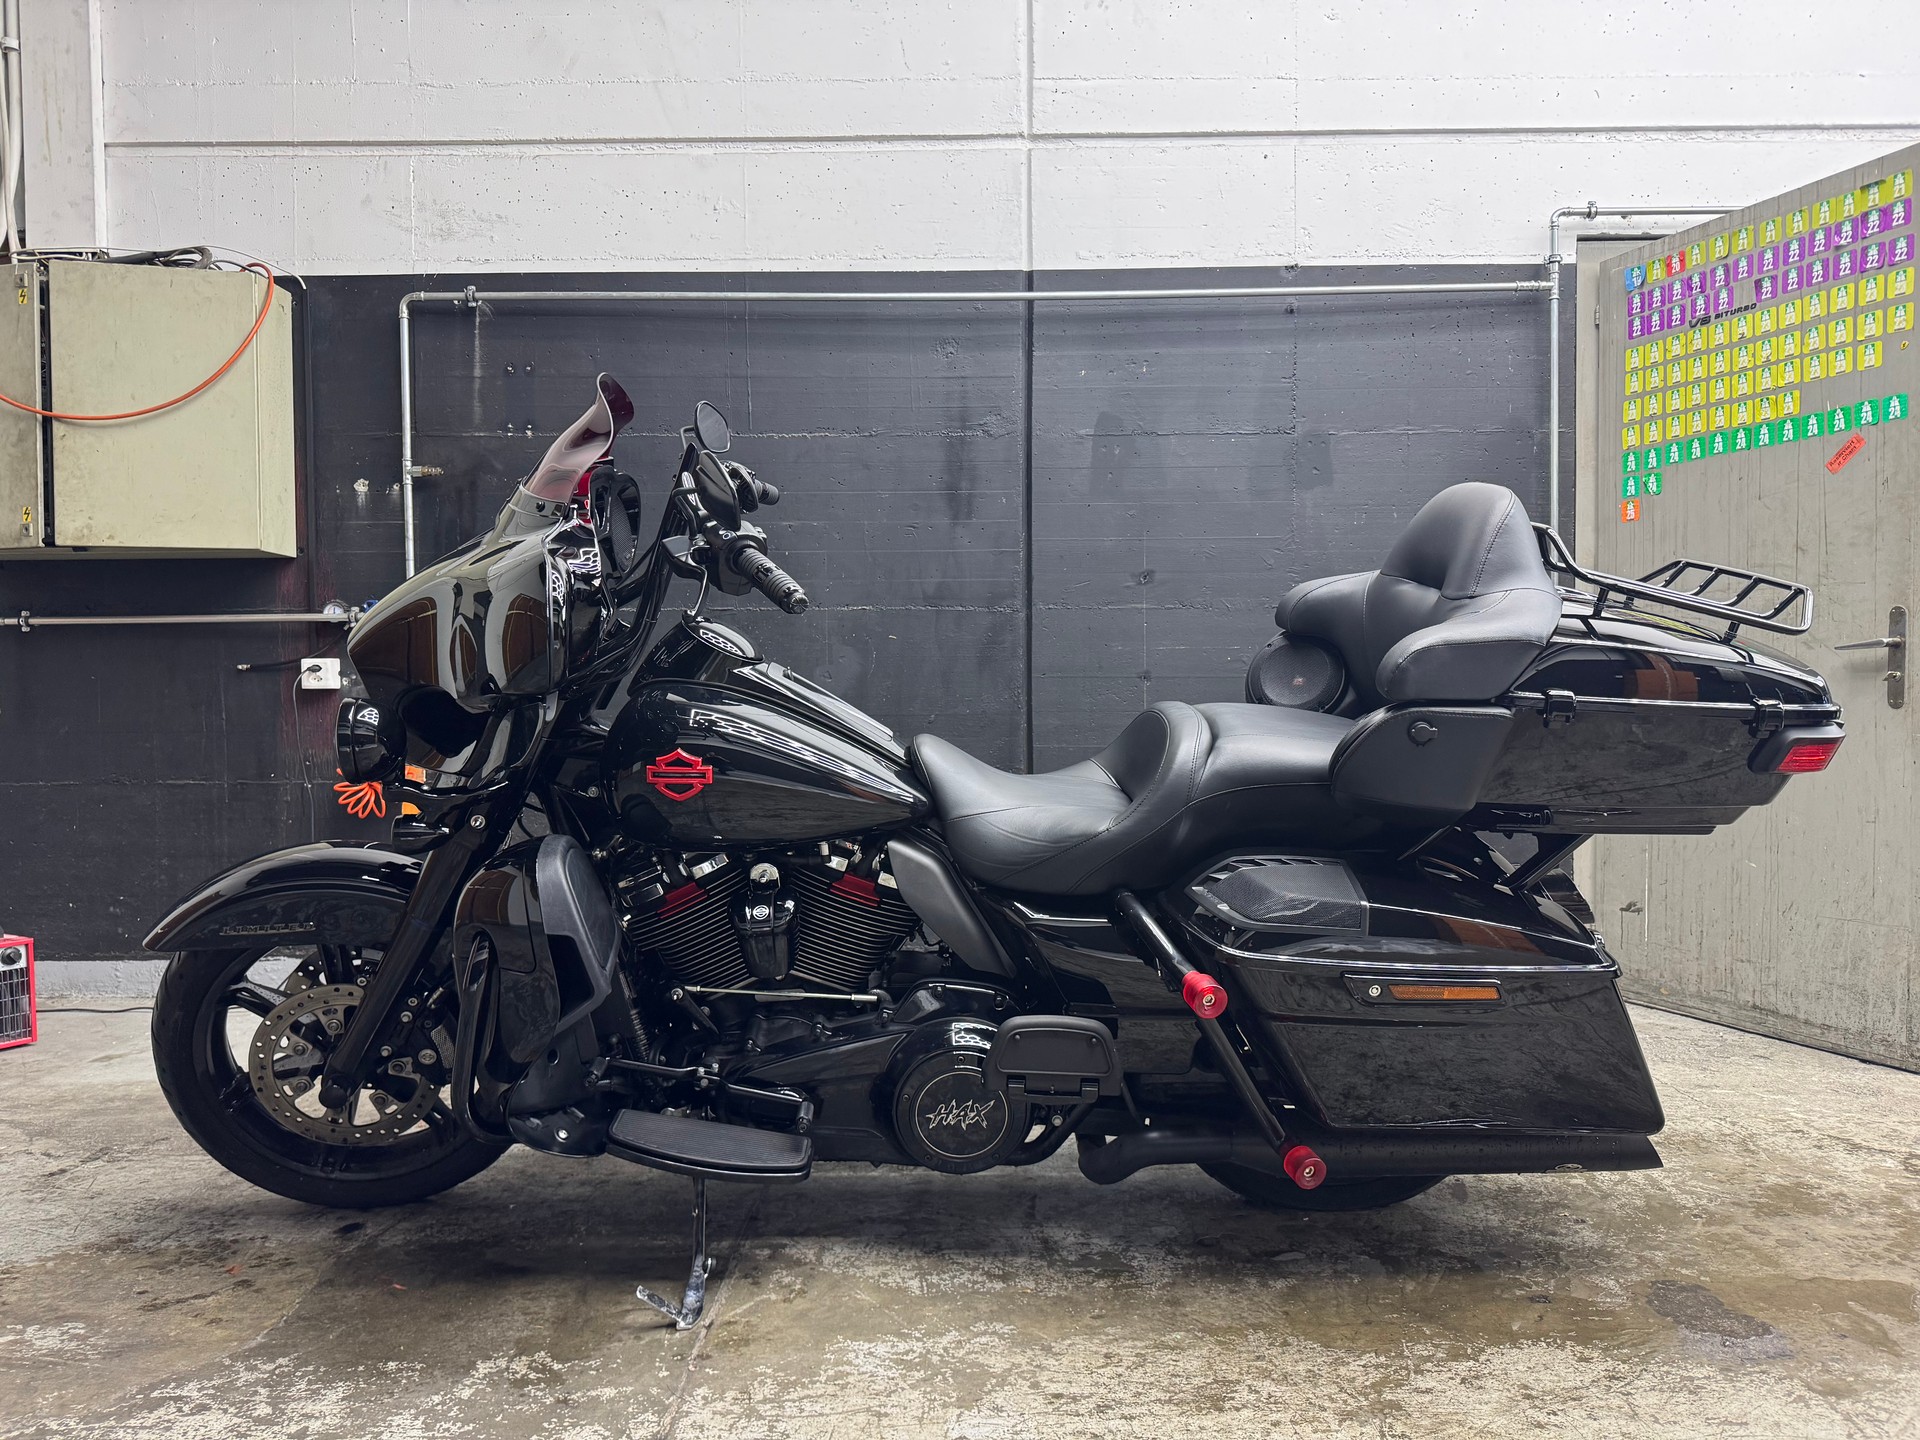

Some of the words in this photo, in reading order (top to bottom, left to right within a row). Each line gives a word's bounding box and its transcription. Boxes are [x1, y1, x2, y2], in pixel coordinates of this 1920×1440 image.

[1893, 213, 1904, 226] 22
[1868, 221, 1879, 233] 22
[1840, 232, 1852, 243] 22
[1814, 240, 1824, 252] 22
[1789, 250, 1799, 262] 22
[1895, 248, 1907, 261] 22
[1672, 262, 1680, 272] 20
[1763, 259, 1773, 270] 22
[1866, 256, 1878, 268] 22
[1738, 268, 1748, 278] 22
[1840, 263, 1850, 275] 22
[1716, 276, 1724, 286] 22
[1812, 271, 1823, 283] 22
[1692, 282, 1700, 293] 22
[1788, 278, 1798, 290] 22
[1673, 290, 1681, 300] 22
[1762, 288, 1771, 299] 22
[1653, 297, 1661, 307] 22
[1719, 298, 1728, 309] 22
[1633, 303, 1641, 313] 22
[1696, 305, 1704, 315] 22
[1672, 315, 1680, 325] 22
[1689, 315, 1711, 328] V8
[1714, 303, 1757, 319] BITURBO
[1633, 326, 1641, 336] 22
[1652, 321, 1660, 331] 22
[1861, 412, 1872, 424] 24
[1889, 407, 1900, 418] 24
[1808, 425, 1818, 436] 24
[1834, 419, 1845, 431] 24
[1759, 434, 1769, 445] 24
[1783, 430, 1793, 441] 24
[1714, 442, 1723, 453] 24
[1736, 438, 1746, 449] 24
[1670, 453, 1678, 462] 24
[1692, 448, 1700, 459] 24
[1627, 461, 1635, 472] 24
[1648, 458, 1656, 468] 24
[1627, 486, 1635, 496] 24
[1627, 510, 1634, 520] 25
[222, 922, 316, 934] LIMITED
